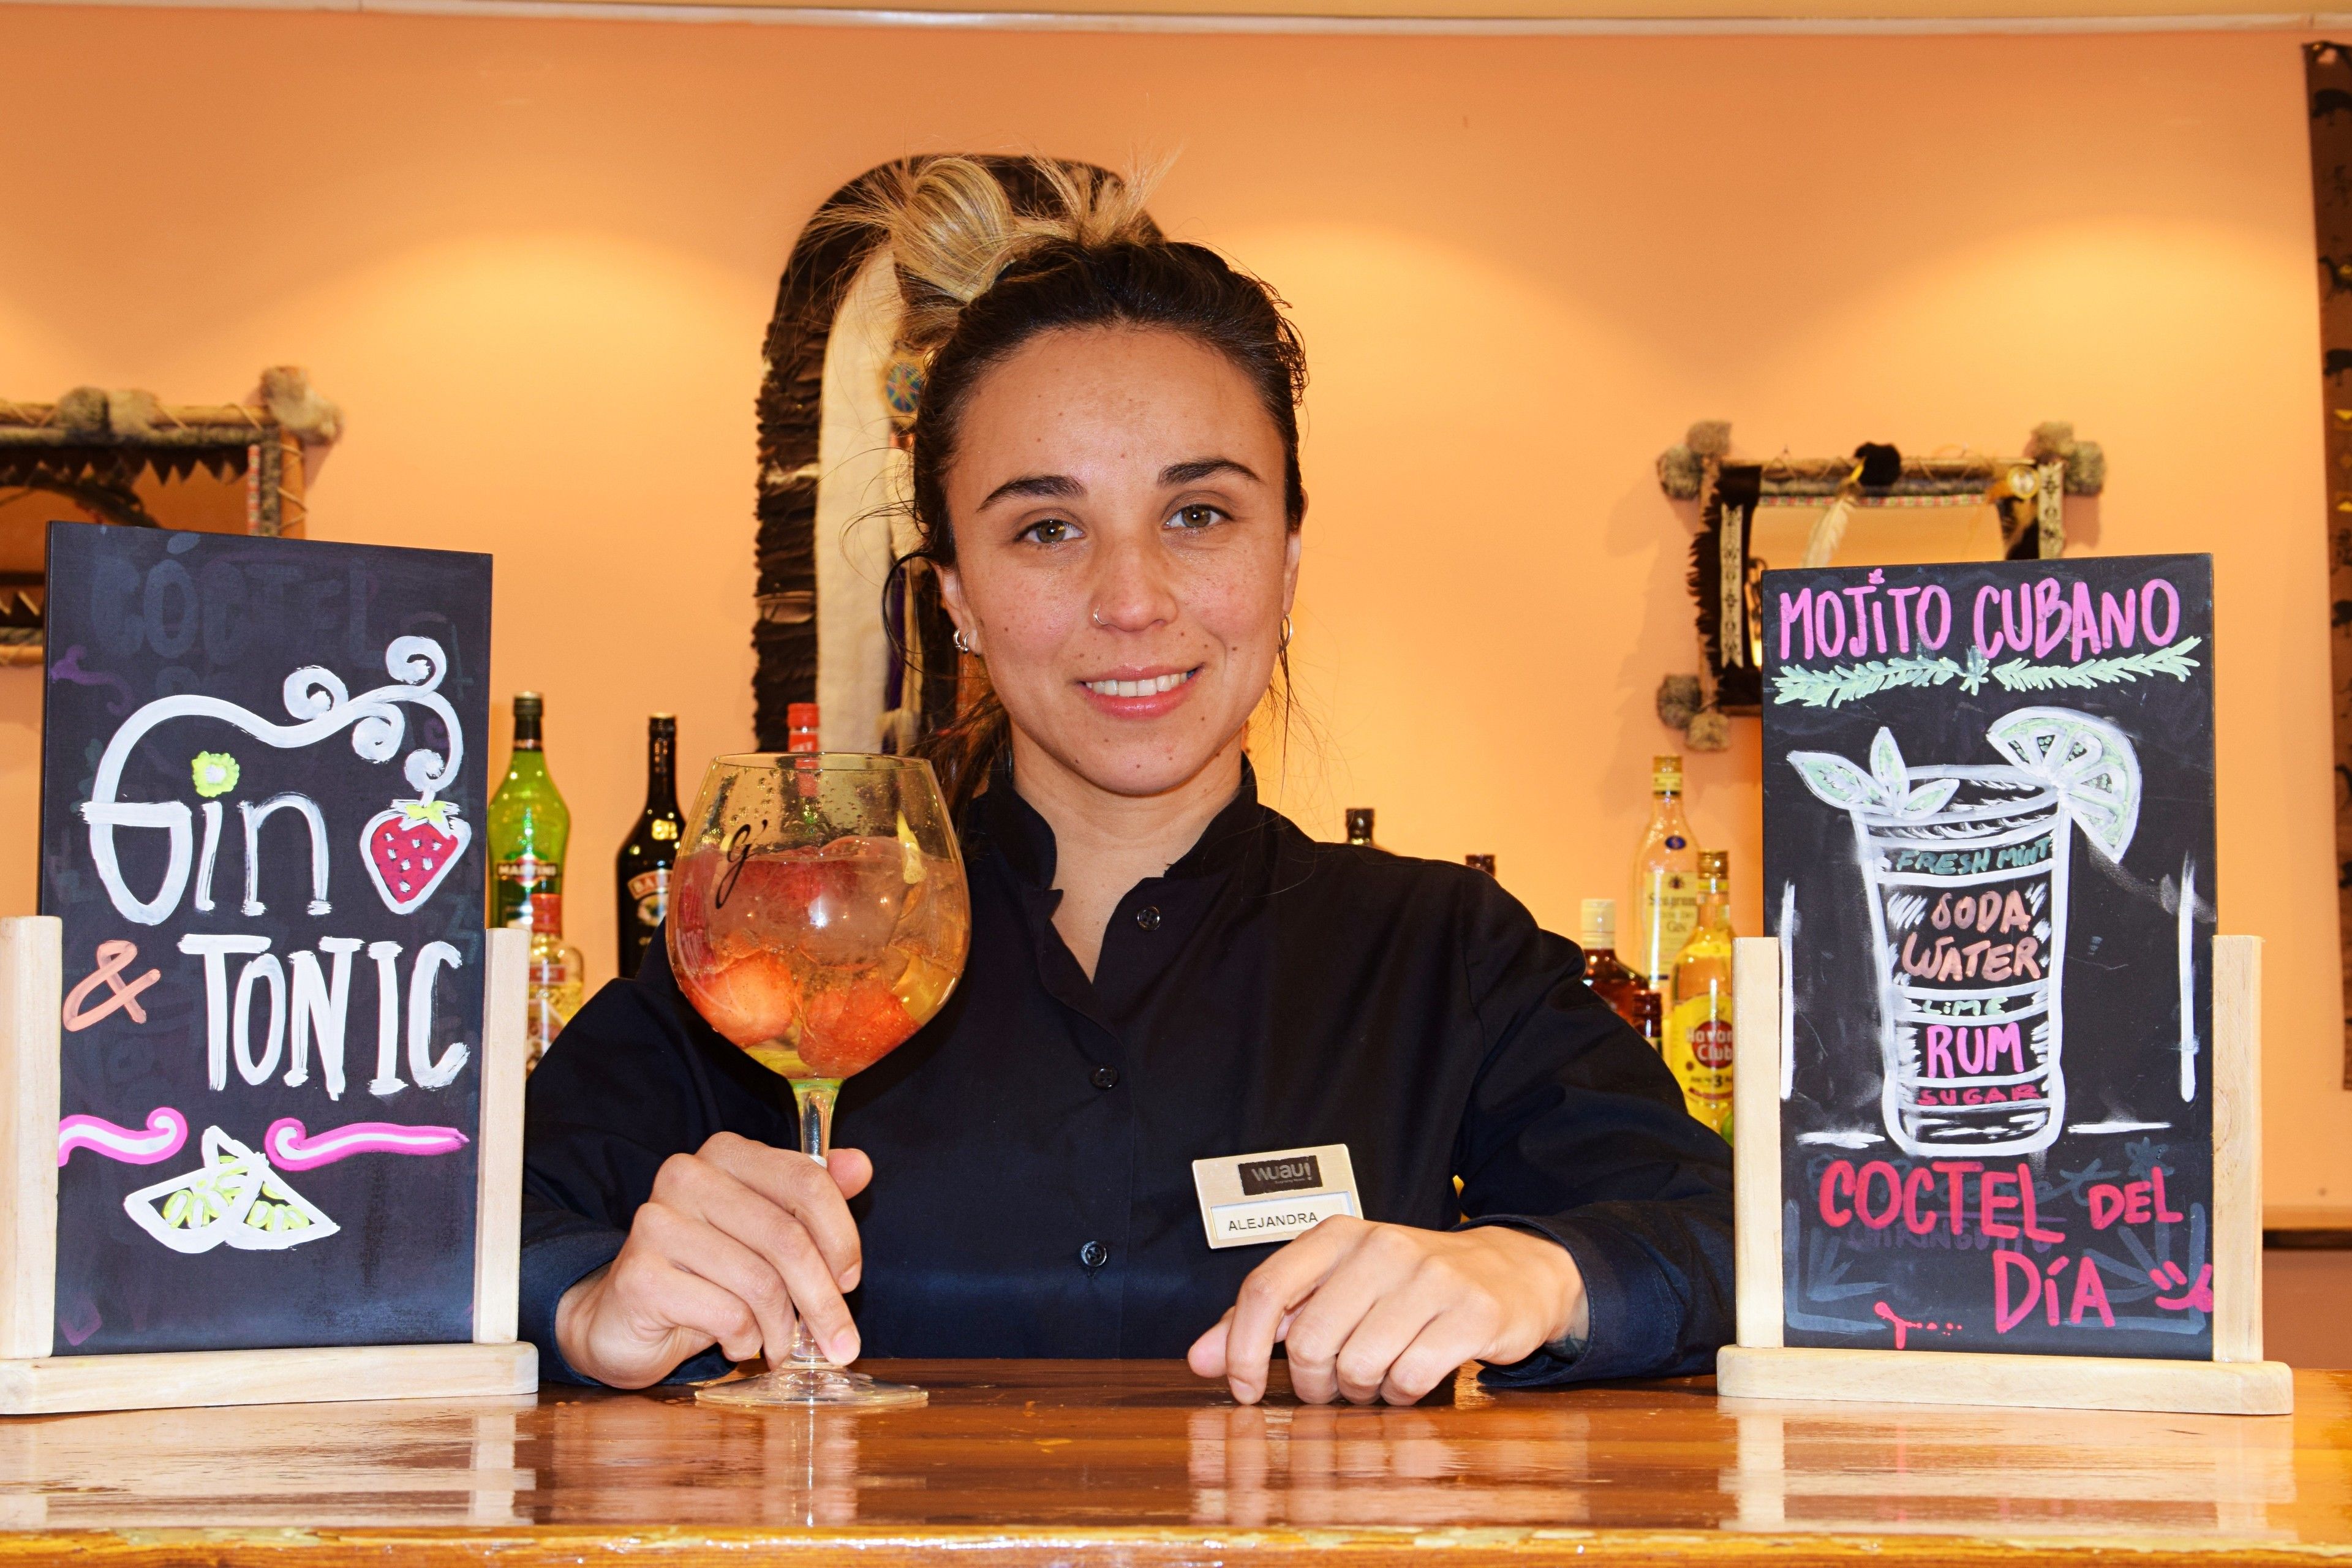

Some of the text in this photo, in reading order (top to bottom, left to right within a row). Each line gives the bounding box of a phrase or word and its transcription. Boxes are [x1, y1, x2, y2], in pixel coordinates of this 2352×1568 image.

[1973, 578, 2180, 662] CUBANO
[80, 695, 333, 926] Gin
[1896, 848, 1990, 874] FRESH
[1931, 890, 2031, 933] SODA
[1902, 932, 2040, 981] WATER
[63, 933, 470, 1101] & TONIC
[1927, 1022, 2024, 1079] RUM
[1917, 1085, 2041, 1106] SUGAR
[1228, 1212, 1318, 1231] ALEJANDRA
[1819, 1160, 2065, 1243] COCTEL
[2088, 1167, 2183, 1230] DEL
[1992, 1250, 2116, 1335] DÍA
